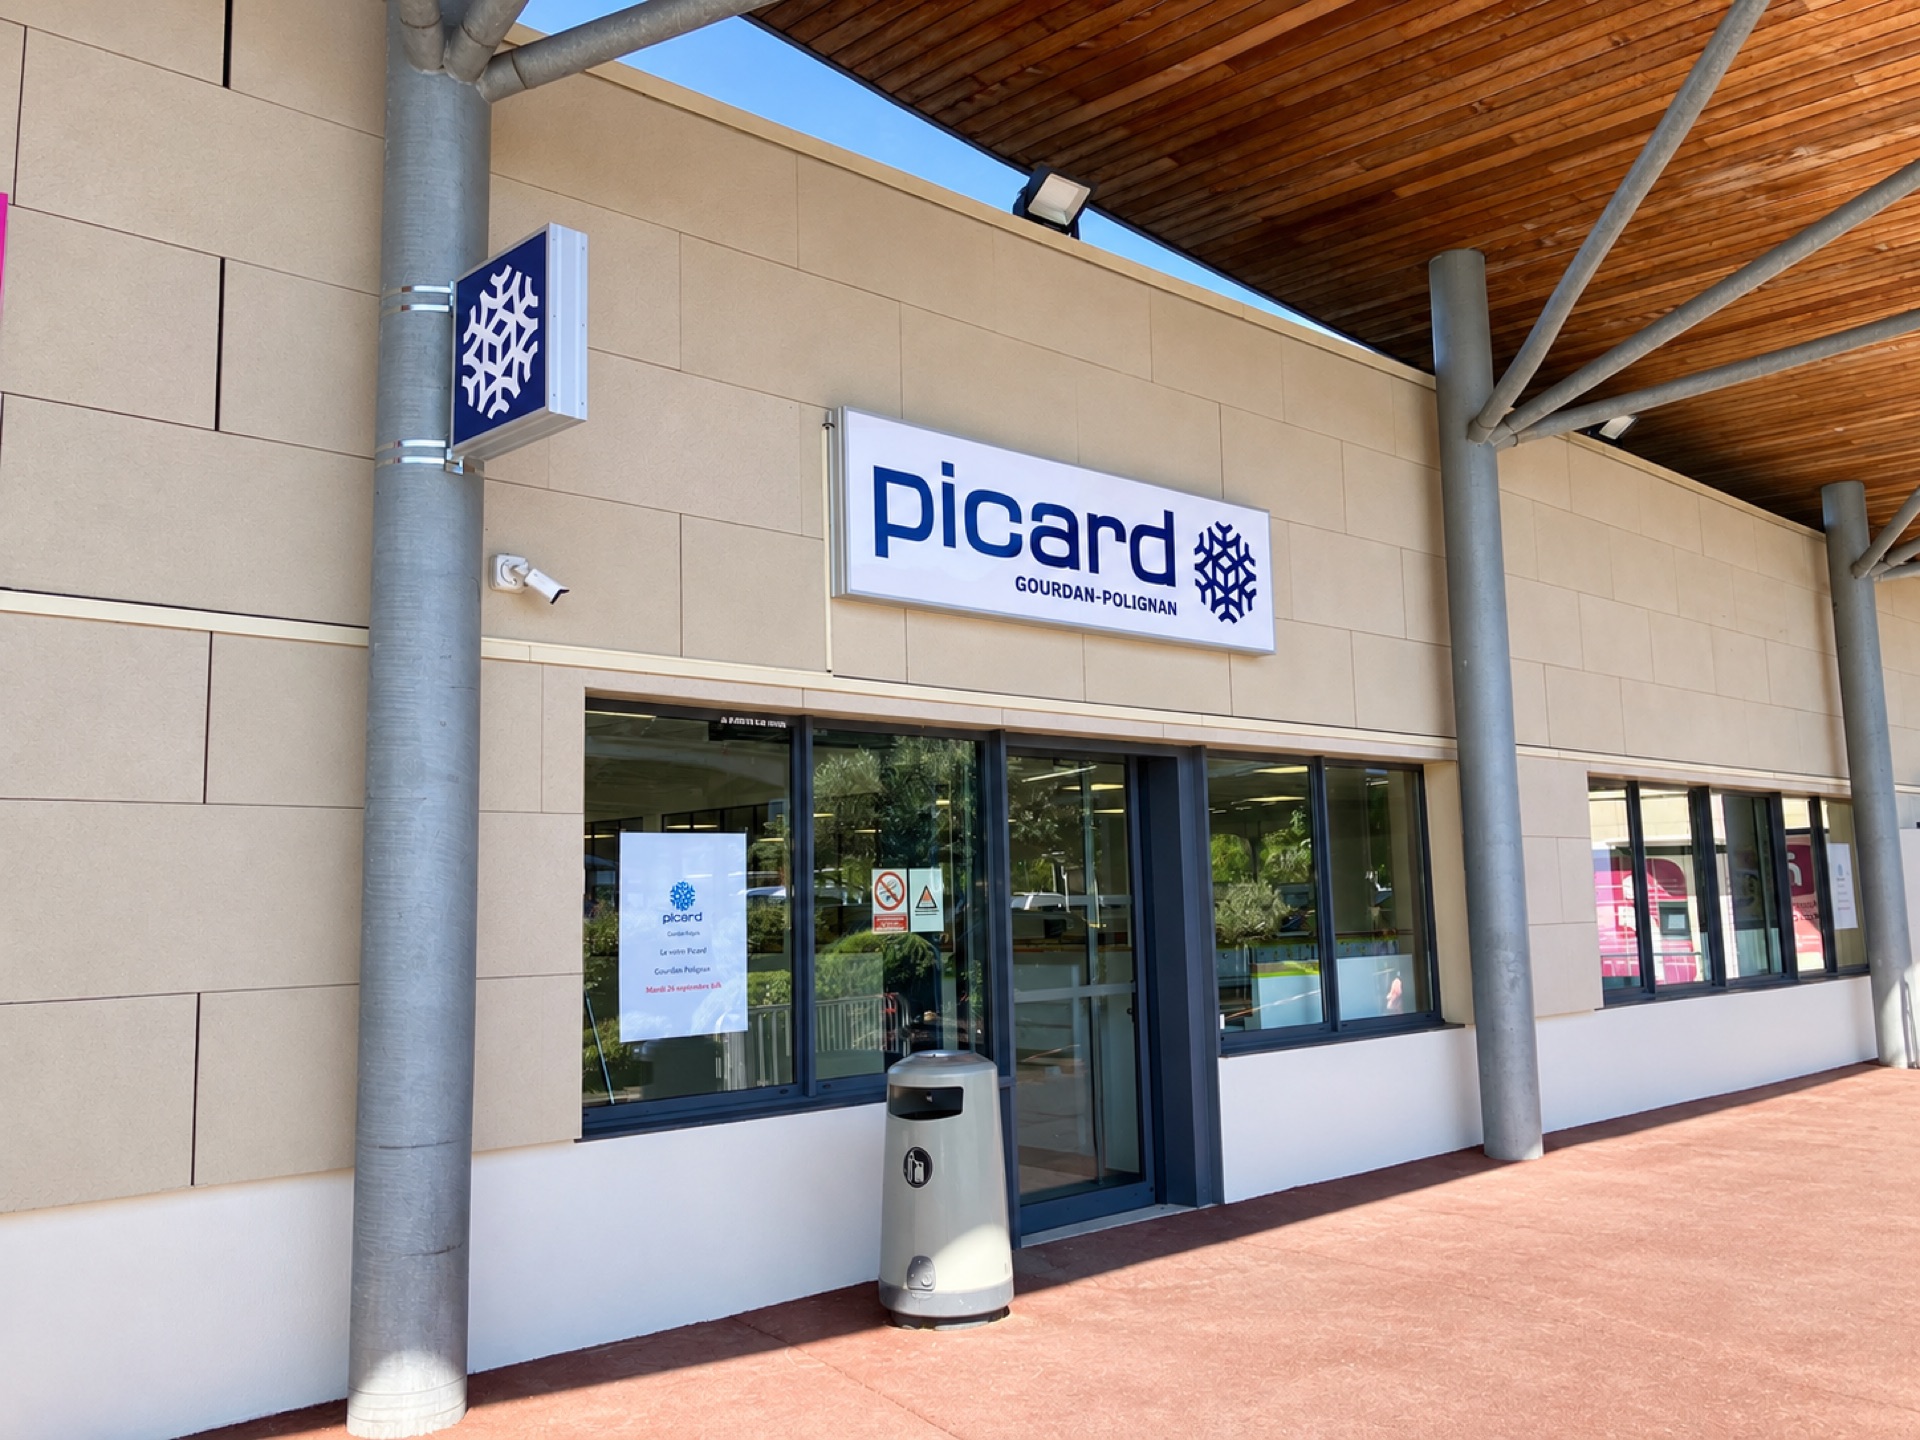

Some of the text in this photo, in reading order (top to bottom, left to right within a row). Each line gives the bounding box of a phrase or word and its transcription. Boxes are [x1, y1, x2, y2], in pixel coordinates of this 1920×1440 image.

[873, 461, 1177, 588] picard
[1015, 575, 1178, 616] GOURDAN-POLIGNAN
[662, 912, 703, 924] picard
